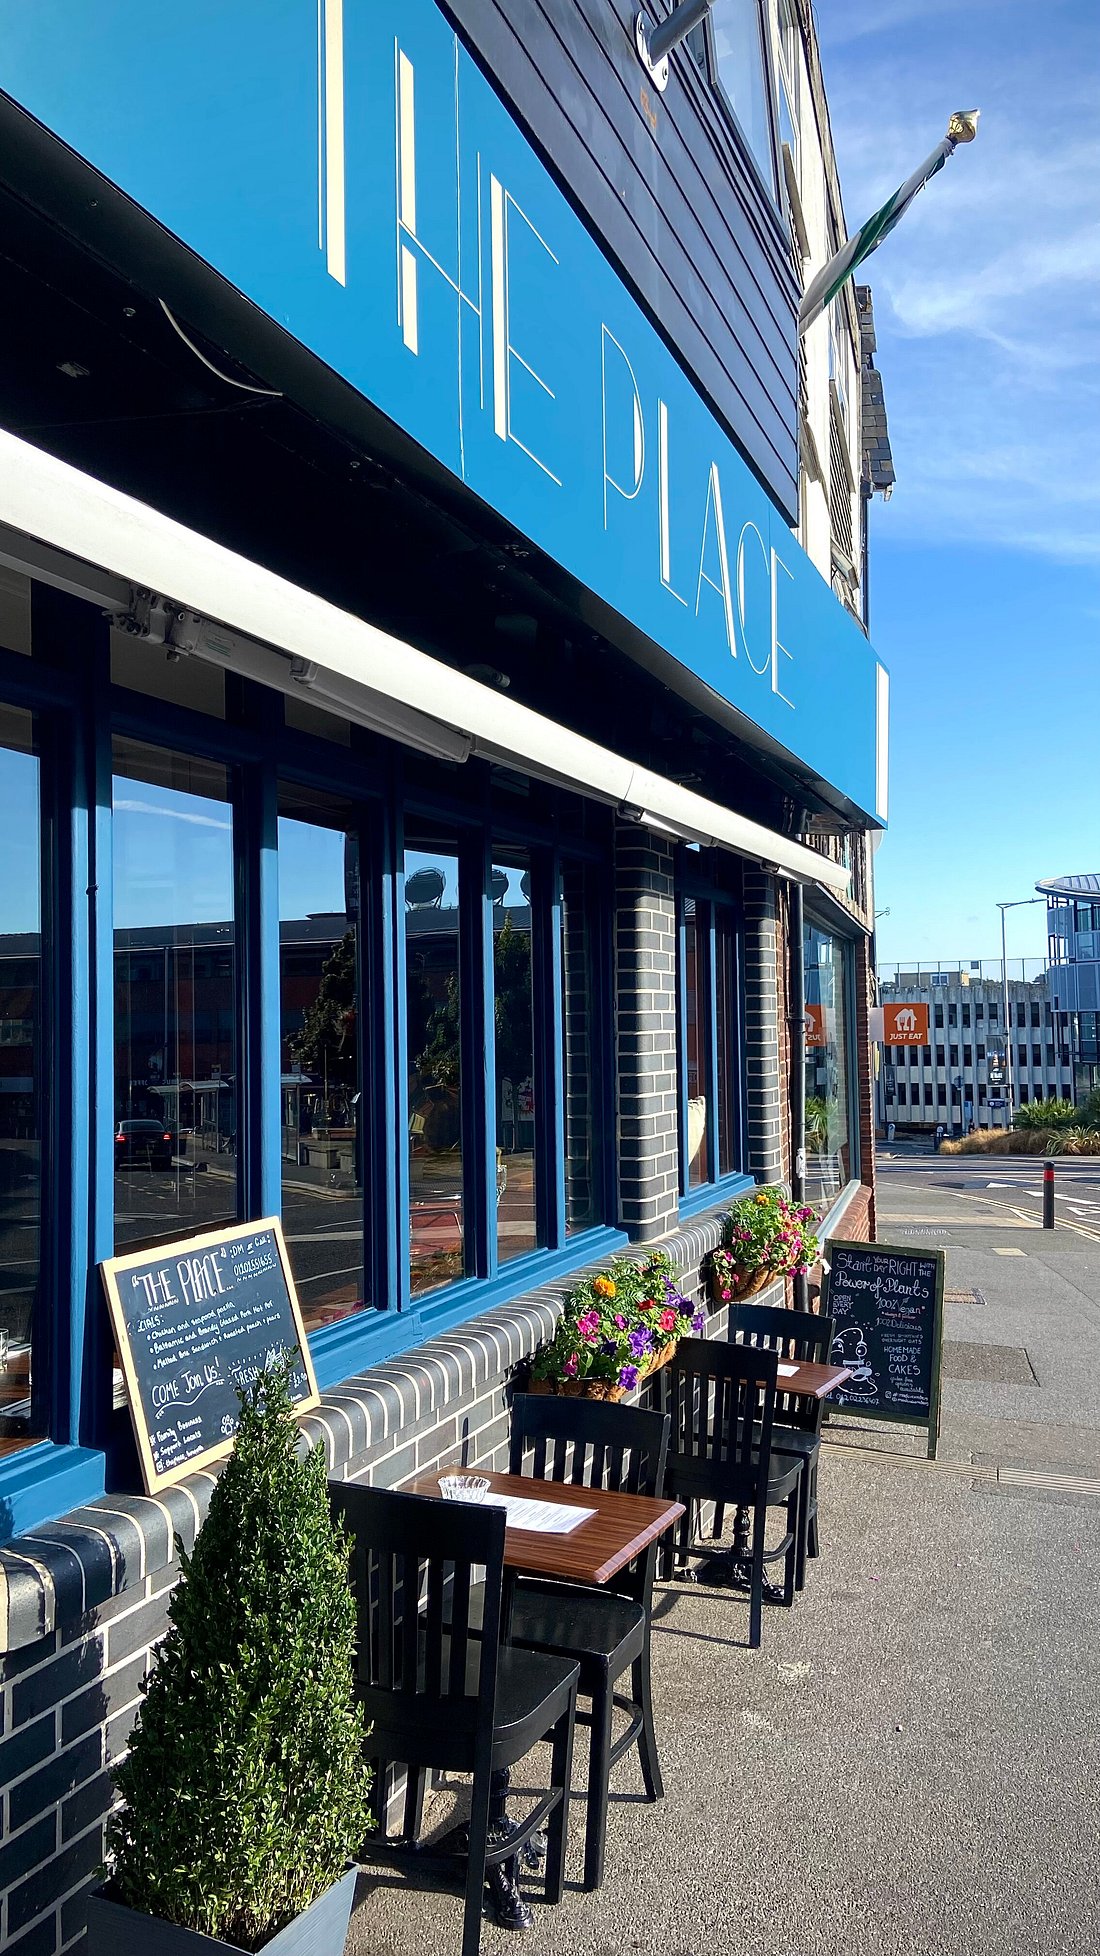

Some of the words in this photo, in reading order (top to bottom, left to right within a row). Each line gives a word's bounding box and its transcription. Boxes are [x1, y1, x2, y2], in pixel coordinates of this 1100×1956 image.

[601, 322, 796, 711] PLACE
[889, 1033, 907, 1041] JUST
[836, 1252, 872, 1273] Start
[872, 1255, 889, 1265] YOUR
[873, 1264, 888, 1273] DAY
[889, 1258, 918, 1277] RIGHT
[919, 1262, 935, 1270] WITH
[918, 1268, 932, 1277] THE
[834, 1270, 870, 1289] Power
[869, 1276, 884, 1299] of
[883, 1277, 929, 1299] Plants
[833, 1294, 851, 1302] OPEN
[875, 1297, 898, 1310] 100%
[832, 1300, 854, 1309] EVERY
[832, 1307, 849, 1315] DAY
[177, 1320, 190, 1331] and
[891, 1319, 922, 1331] Delicious
[153, 1336, 185, 1355] Balsamic
[184, 1331, 197, 1342] and
[910, 1354, 917, 1363] &
[888, 1363, 921, 1376] CAKES
[152, 1379, 180, 1407] COME
[160, 1440, 181, 1456] Support
